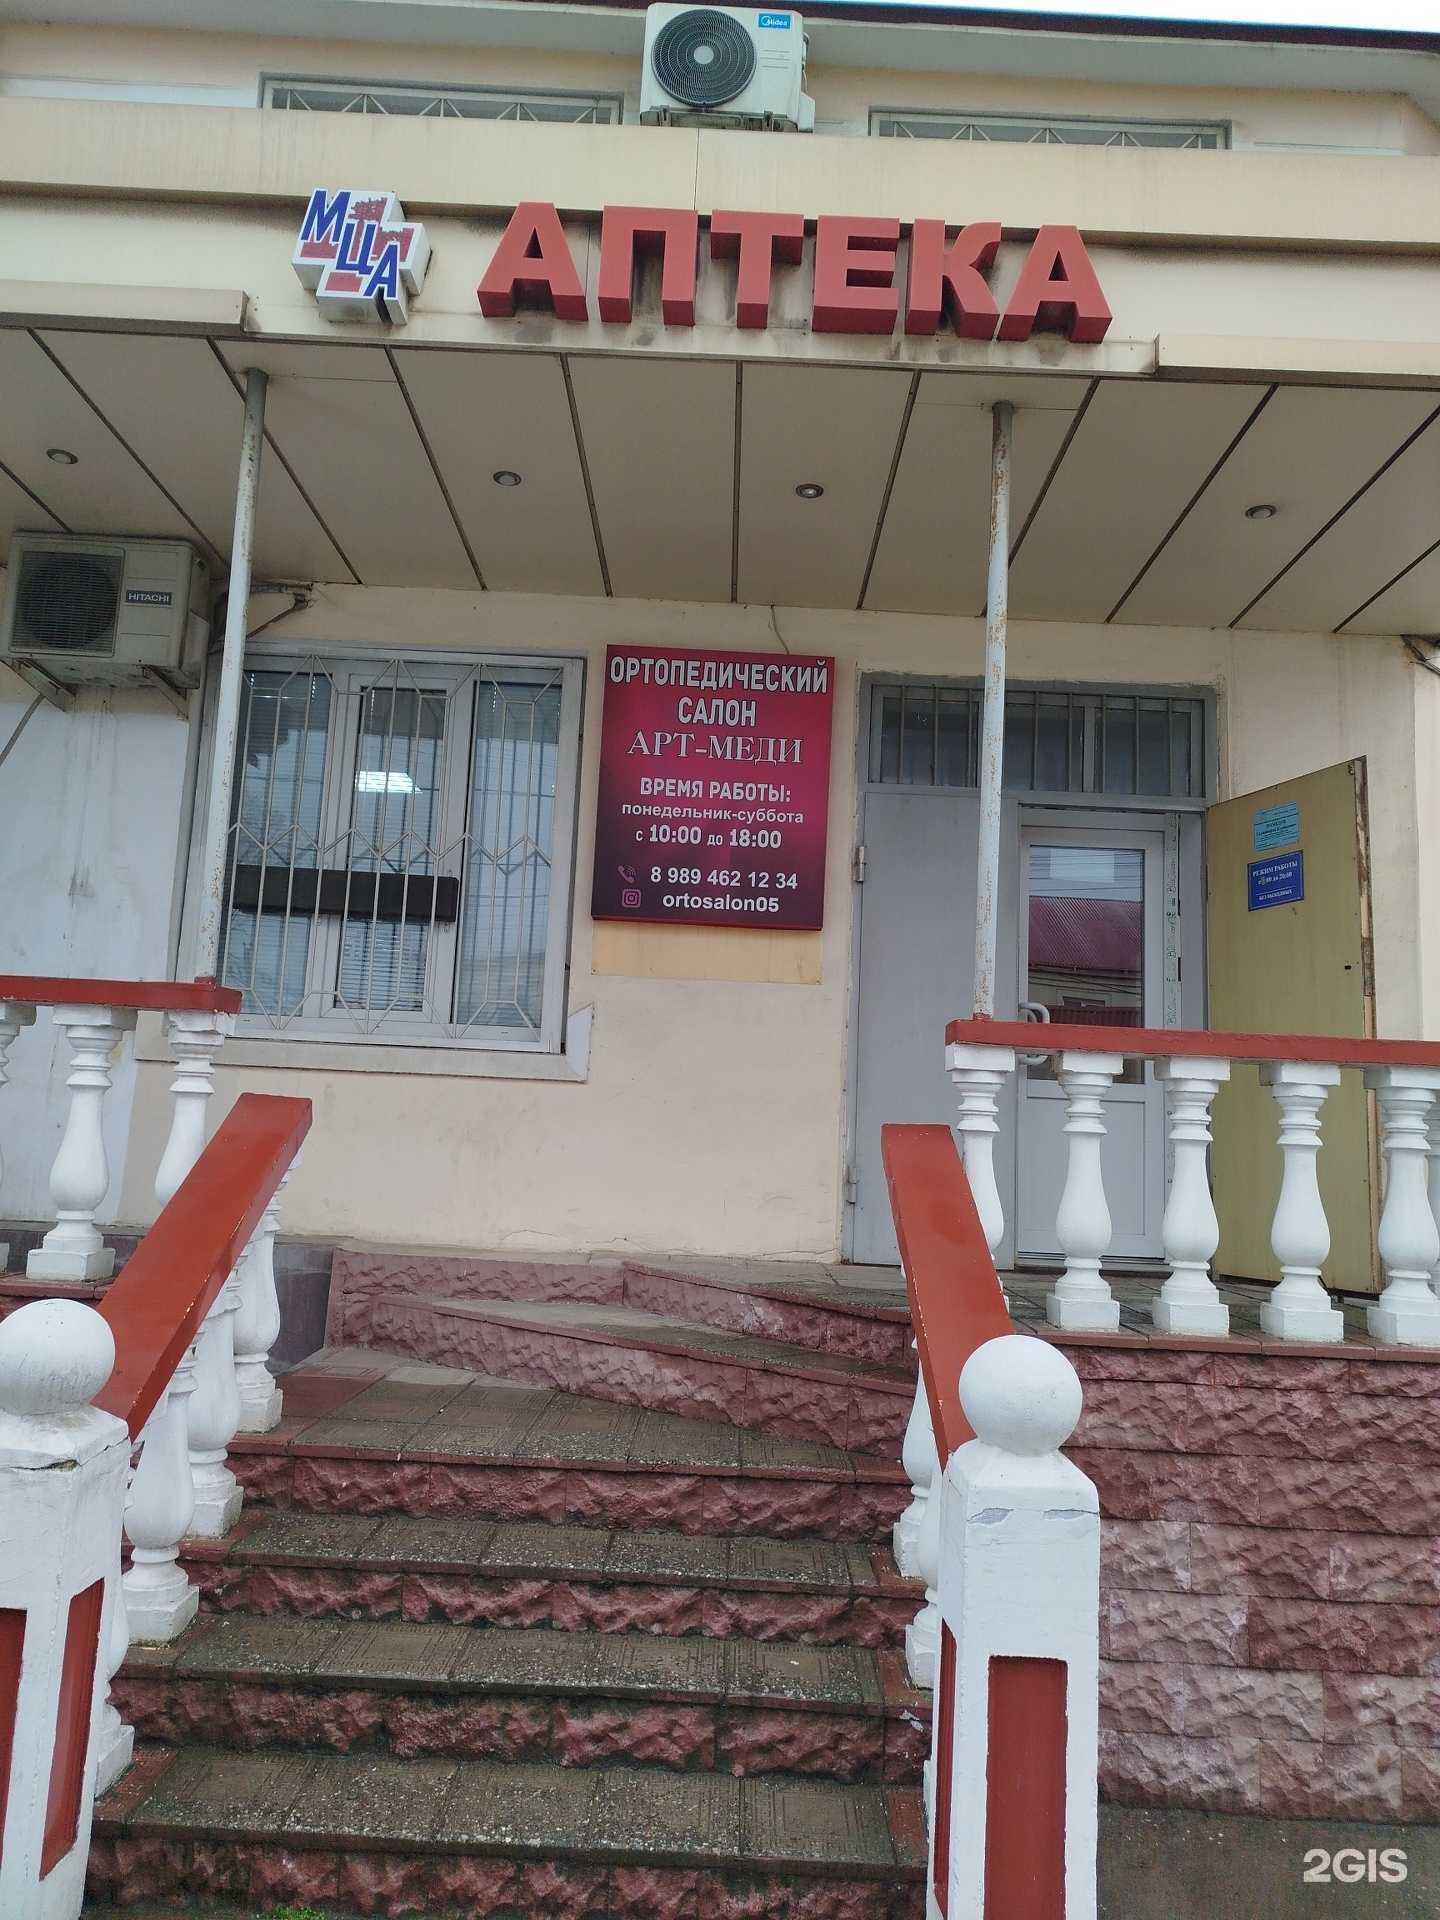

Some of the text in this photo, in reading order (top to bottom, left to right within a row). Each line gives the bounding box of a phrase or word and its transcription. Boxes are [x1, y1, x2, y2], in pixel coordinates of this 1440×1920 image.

[300, 189, 399, 298] МЦА
[477, 201, 1113, 344] АПТЕКА
[128, 592, 169, 602] HITACHI
[609, 655, 828, 693] ОРТОПЕДИЧЕСКИЙ
[677, 696, 757, 727] САЛОН
[626, 730, 803, 766] АРТ-МЕДИ
[640, 777, 791, 802] ВРЕМЯ РАБОТЫ:
[621, 803, 804, 824] понедельник-суббота
[635, 824, 782, 849] с 10:00 до 18:00
[650, 867, 798, 890] 8 989 462 12 34
[662, 892, 780, 913] ortosalon05
